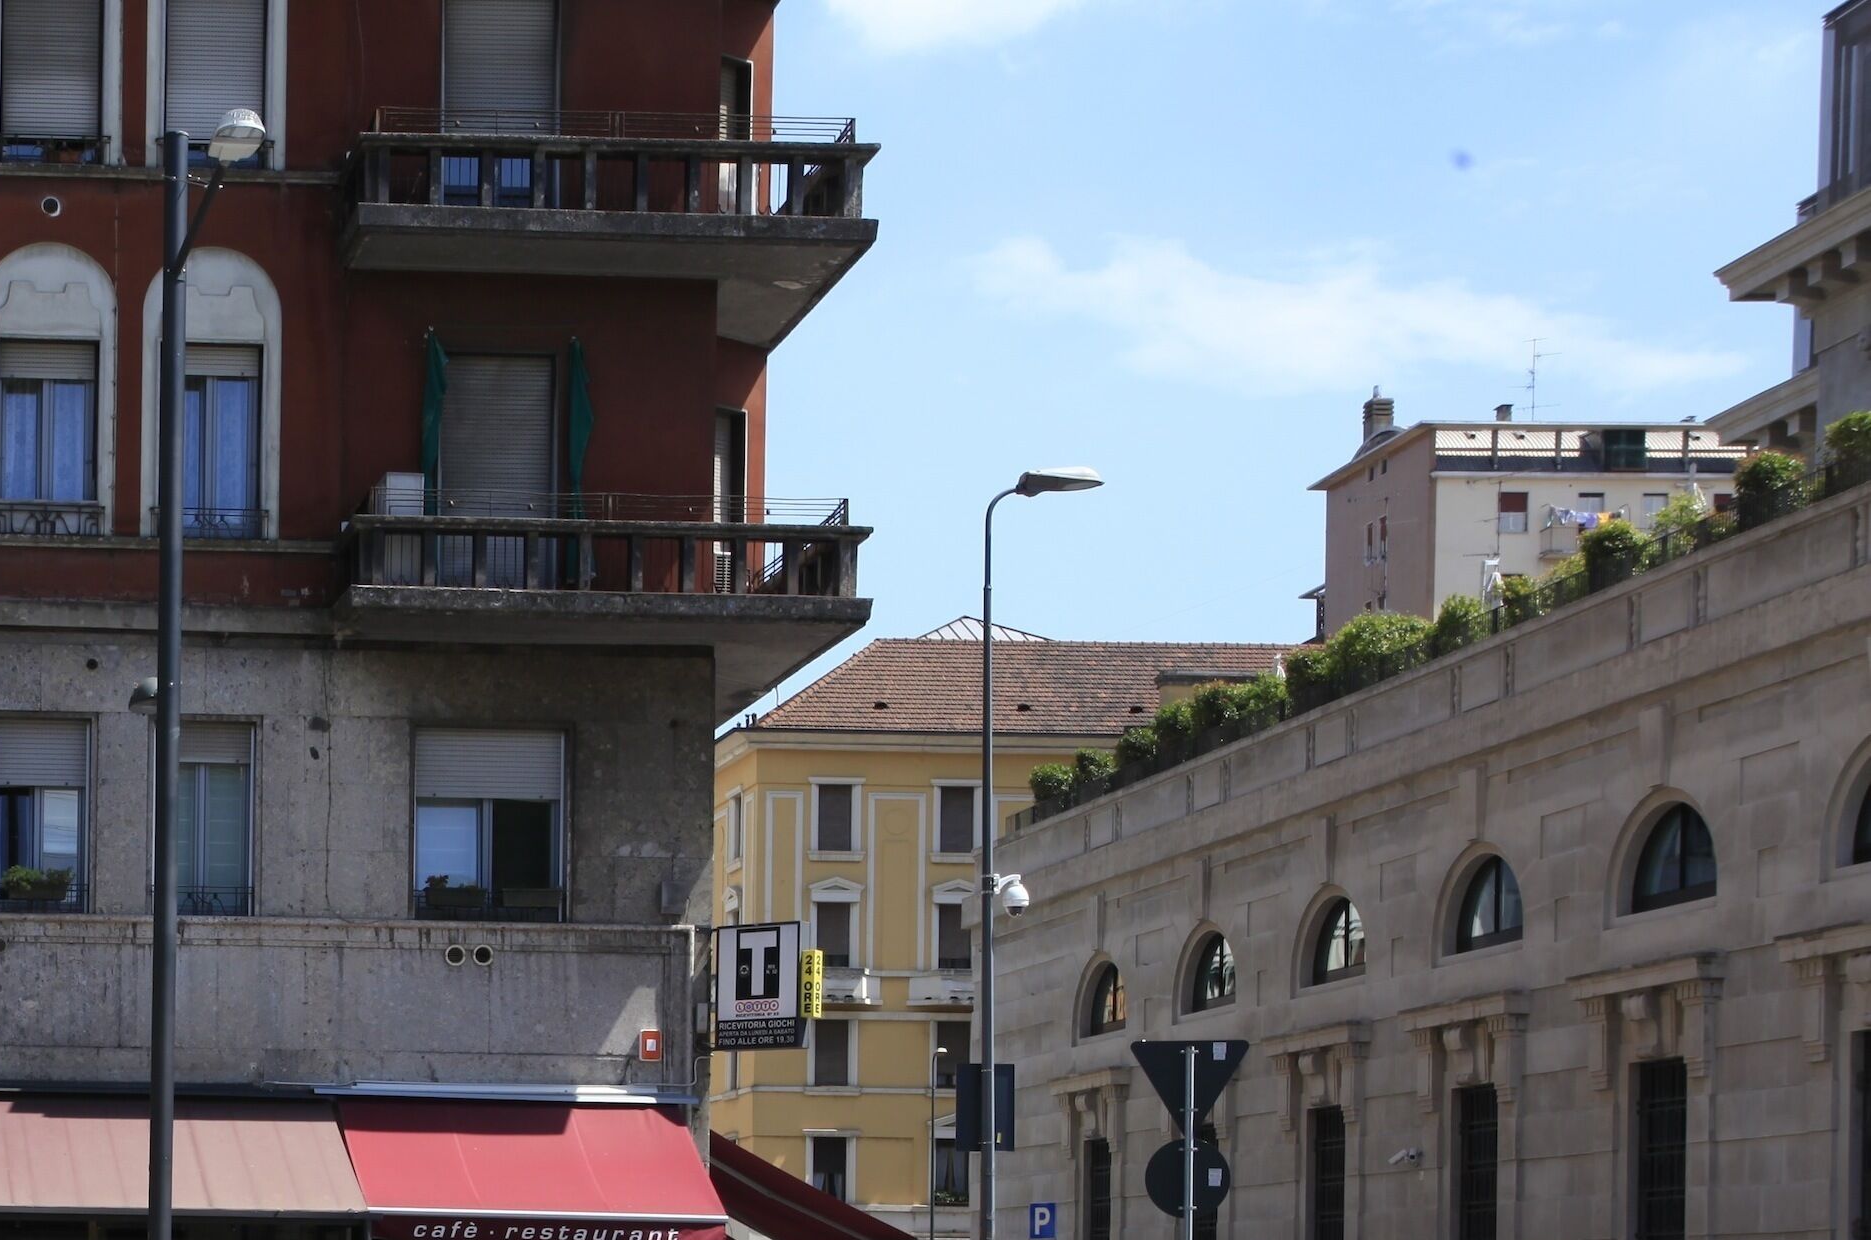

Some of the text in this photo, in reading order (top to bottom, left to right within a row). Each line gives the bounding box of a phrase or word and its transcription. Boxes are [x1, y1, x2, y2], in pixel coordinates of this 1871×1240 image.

[740, 931, 777, 996] T
[804, 955, 813, 1014] 24 ORE
[735, 1000, 779, 1013] LOTTO
[719, 1019, 795, 1030] RICEVITORIA GIOCHI
[718, 1037, 736, 1046] FINO
[737, 1036, 757, 1045] ALLE
[758, 1036, 774, 1044] ORE
[413, 1221, 478, 1239] cafè
[1034, 1207, 1050, 1235] P
